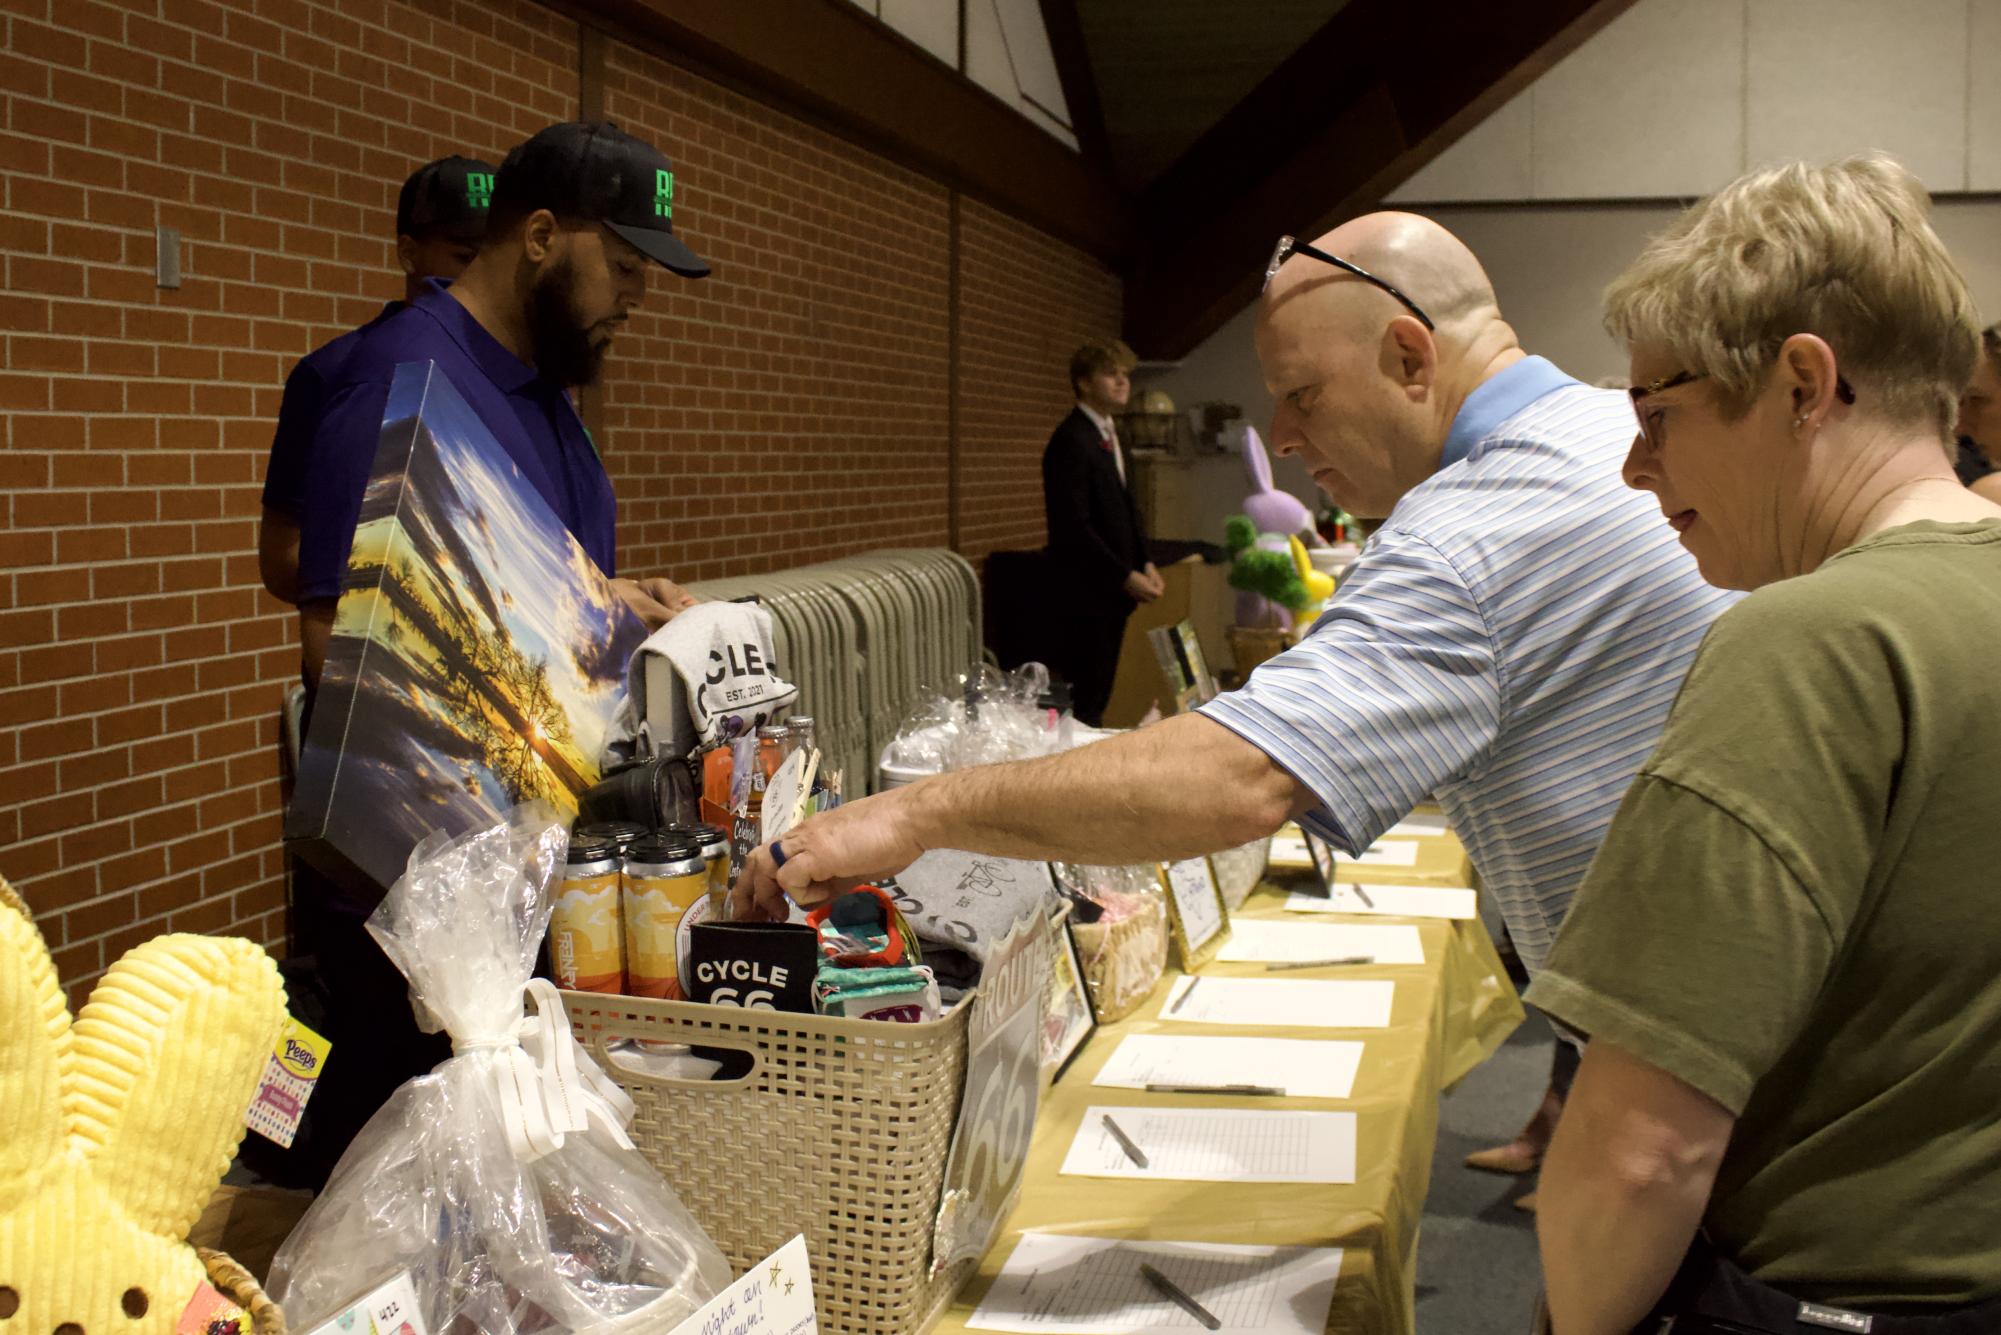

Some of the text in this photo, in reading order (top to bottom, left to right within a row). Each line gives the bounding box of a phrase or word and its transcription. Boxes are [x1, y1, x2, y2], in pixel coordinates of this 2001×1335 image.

[725, 684, 764, 702] EST. 2021
[697, 960, 789, 989] CYCLE
[285, 1038, 318, 1070] Peeps
